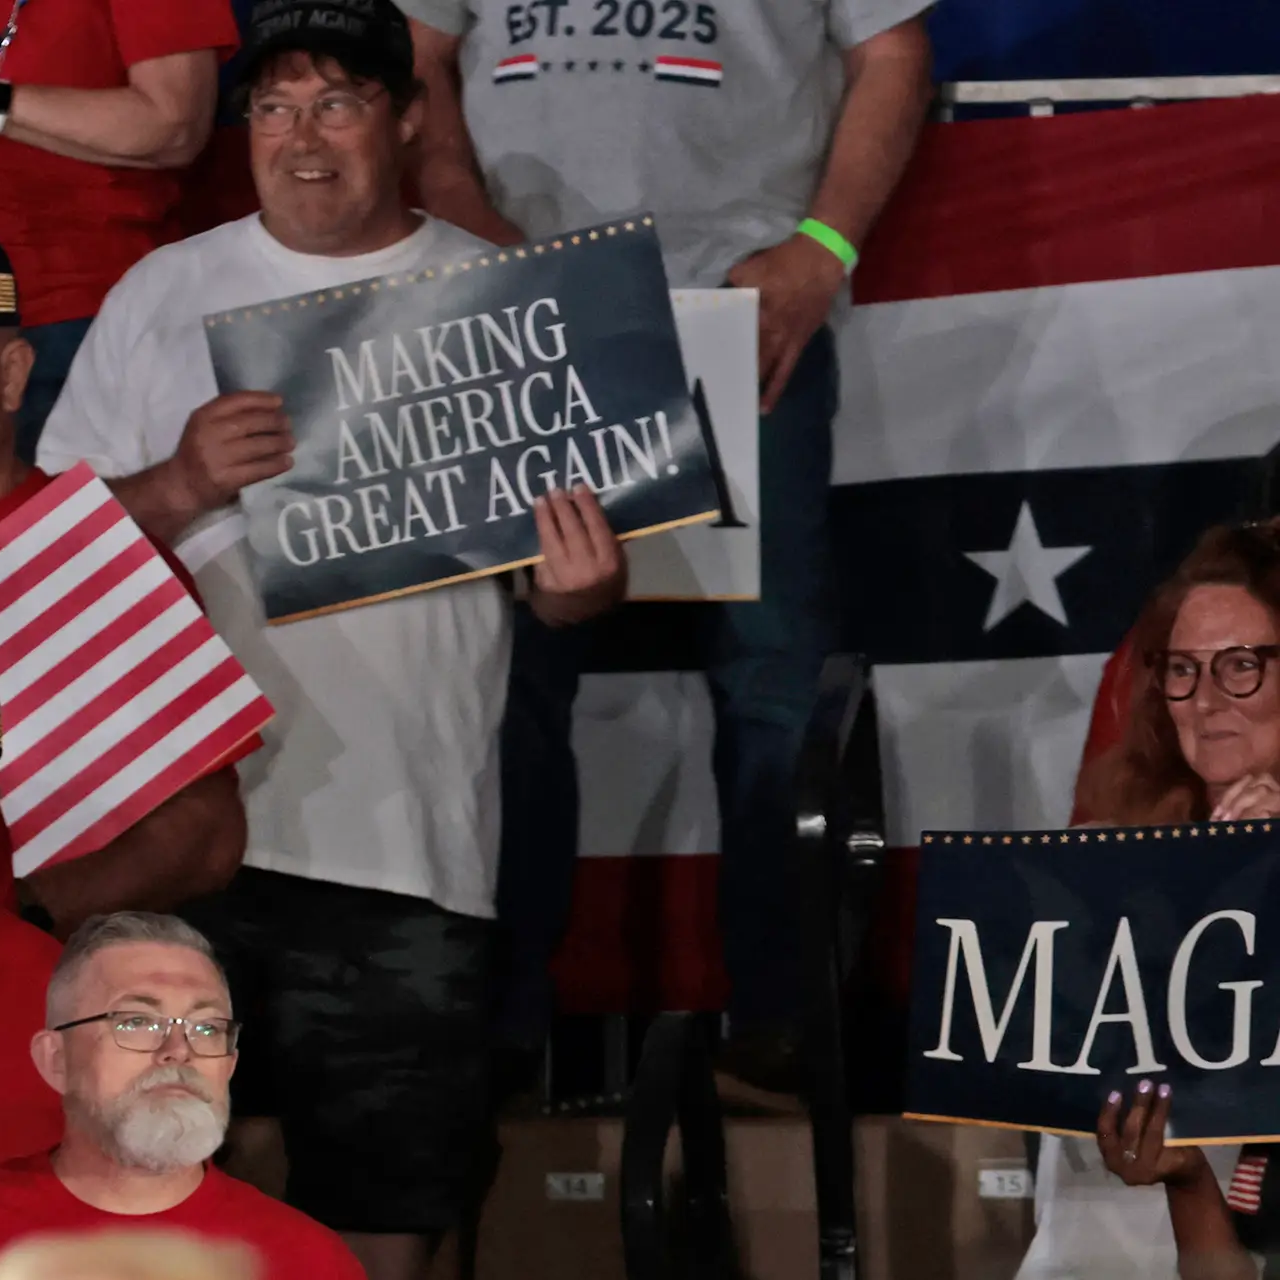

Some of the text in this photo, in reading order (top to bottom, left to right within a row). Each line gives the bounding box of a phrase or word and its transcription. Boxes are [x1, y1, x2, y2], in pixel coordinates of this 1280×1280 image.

[506, 0, 719, 44] EST. 2025
[325, 297, 568, 411] MAKING
[333, 364, 603, 485] AMERICA
[276, 465, 468, 567] GREAT
[484, 410, 679, 523] AGAIN!
[923, 909, 1280, 1075] MAG
